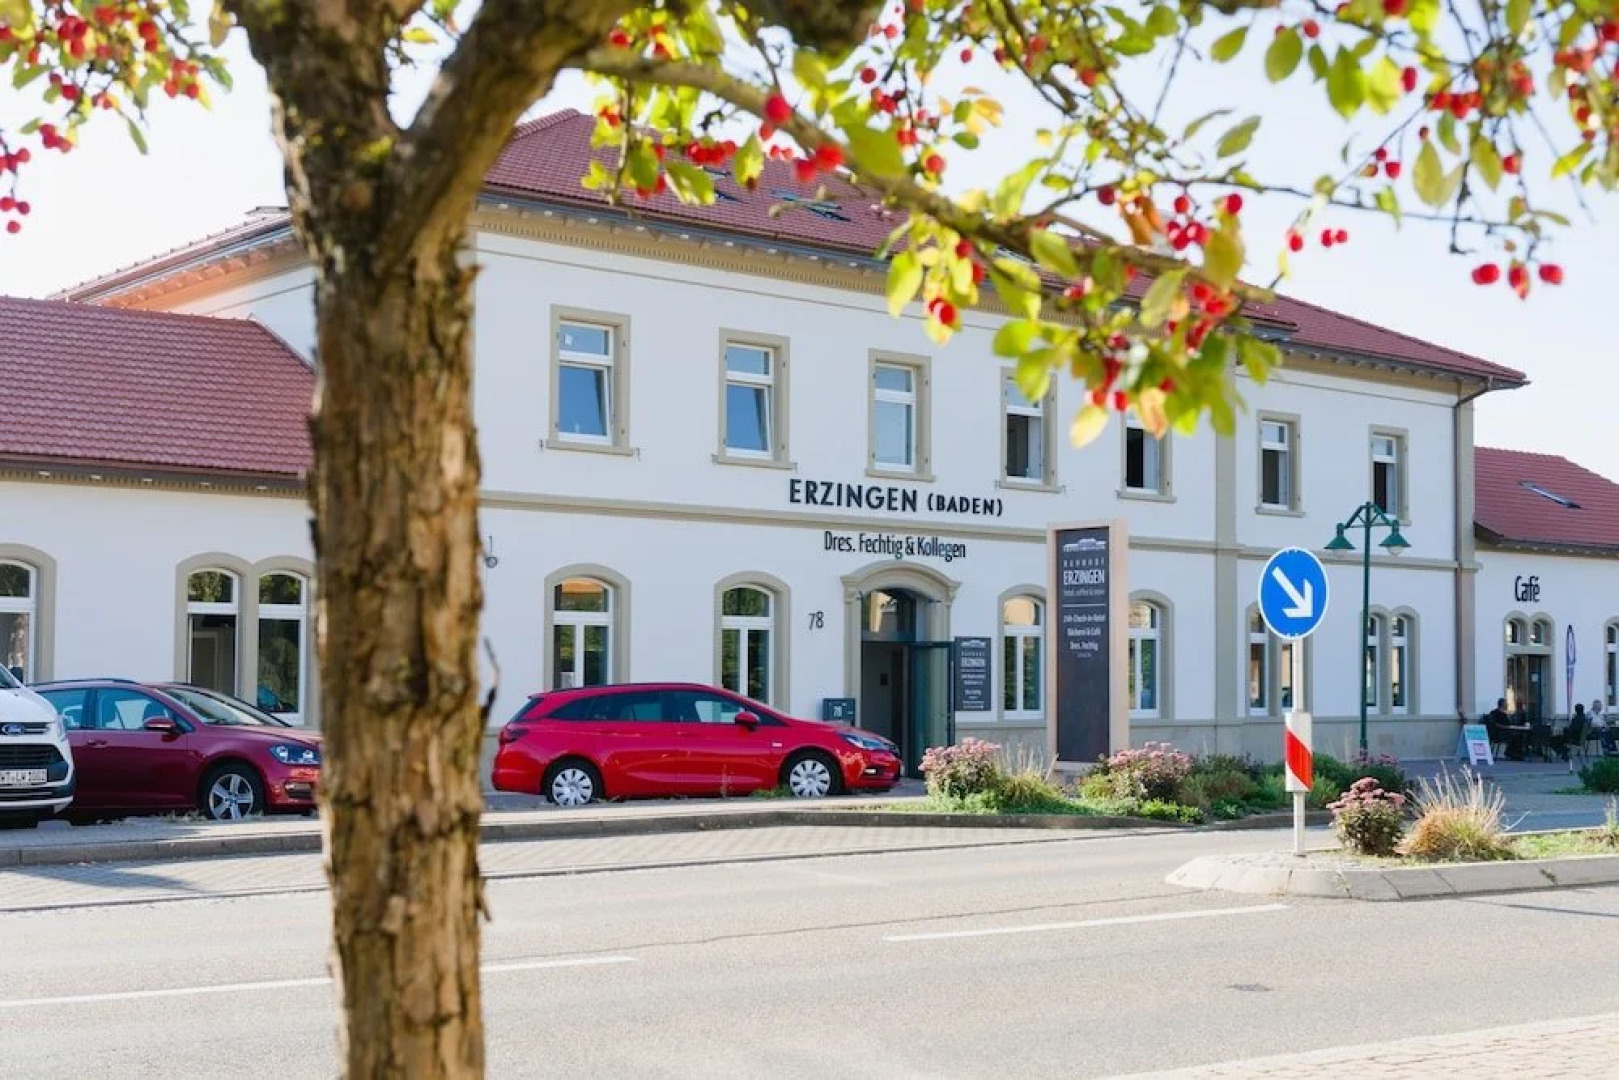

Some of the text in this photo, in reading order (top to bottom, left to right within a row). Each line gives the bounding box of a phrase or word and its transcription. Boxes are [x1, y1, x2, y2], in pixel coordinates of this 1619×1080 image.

[789, 478, 1003, 517] ERZINGEN (BADEN)
[824, 530, 966, 562] Dres. Fechtig & Kollegen
[1063, 569, 1105, 586] ERZINGEN
[1514, 575, 1540, 602] Café
[808, 611, 824, 630] 78
